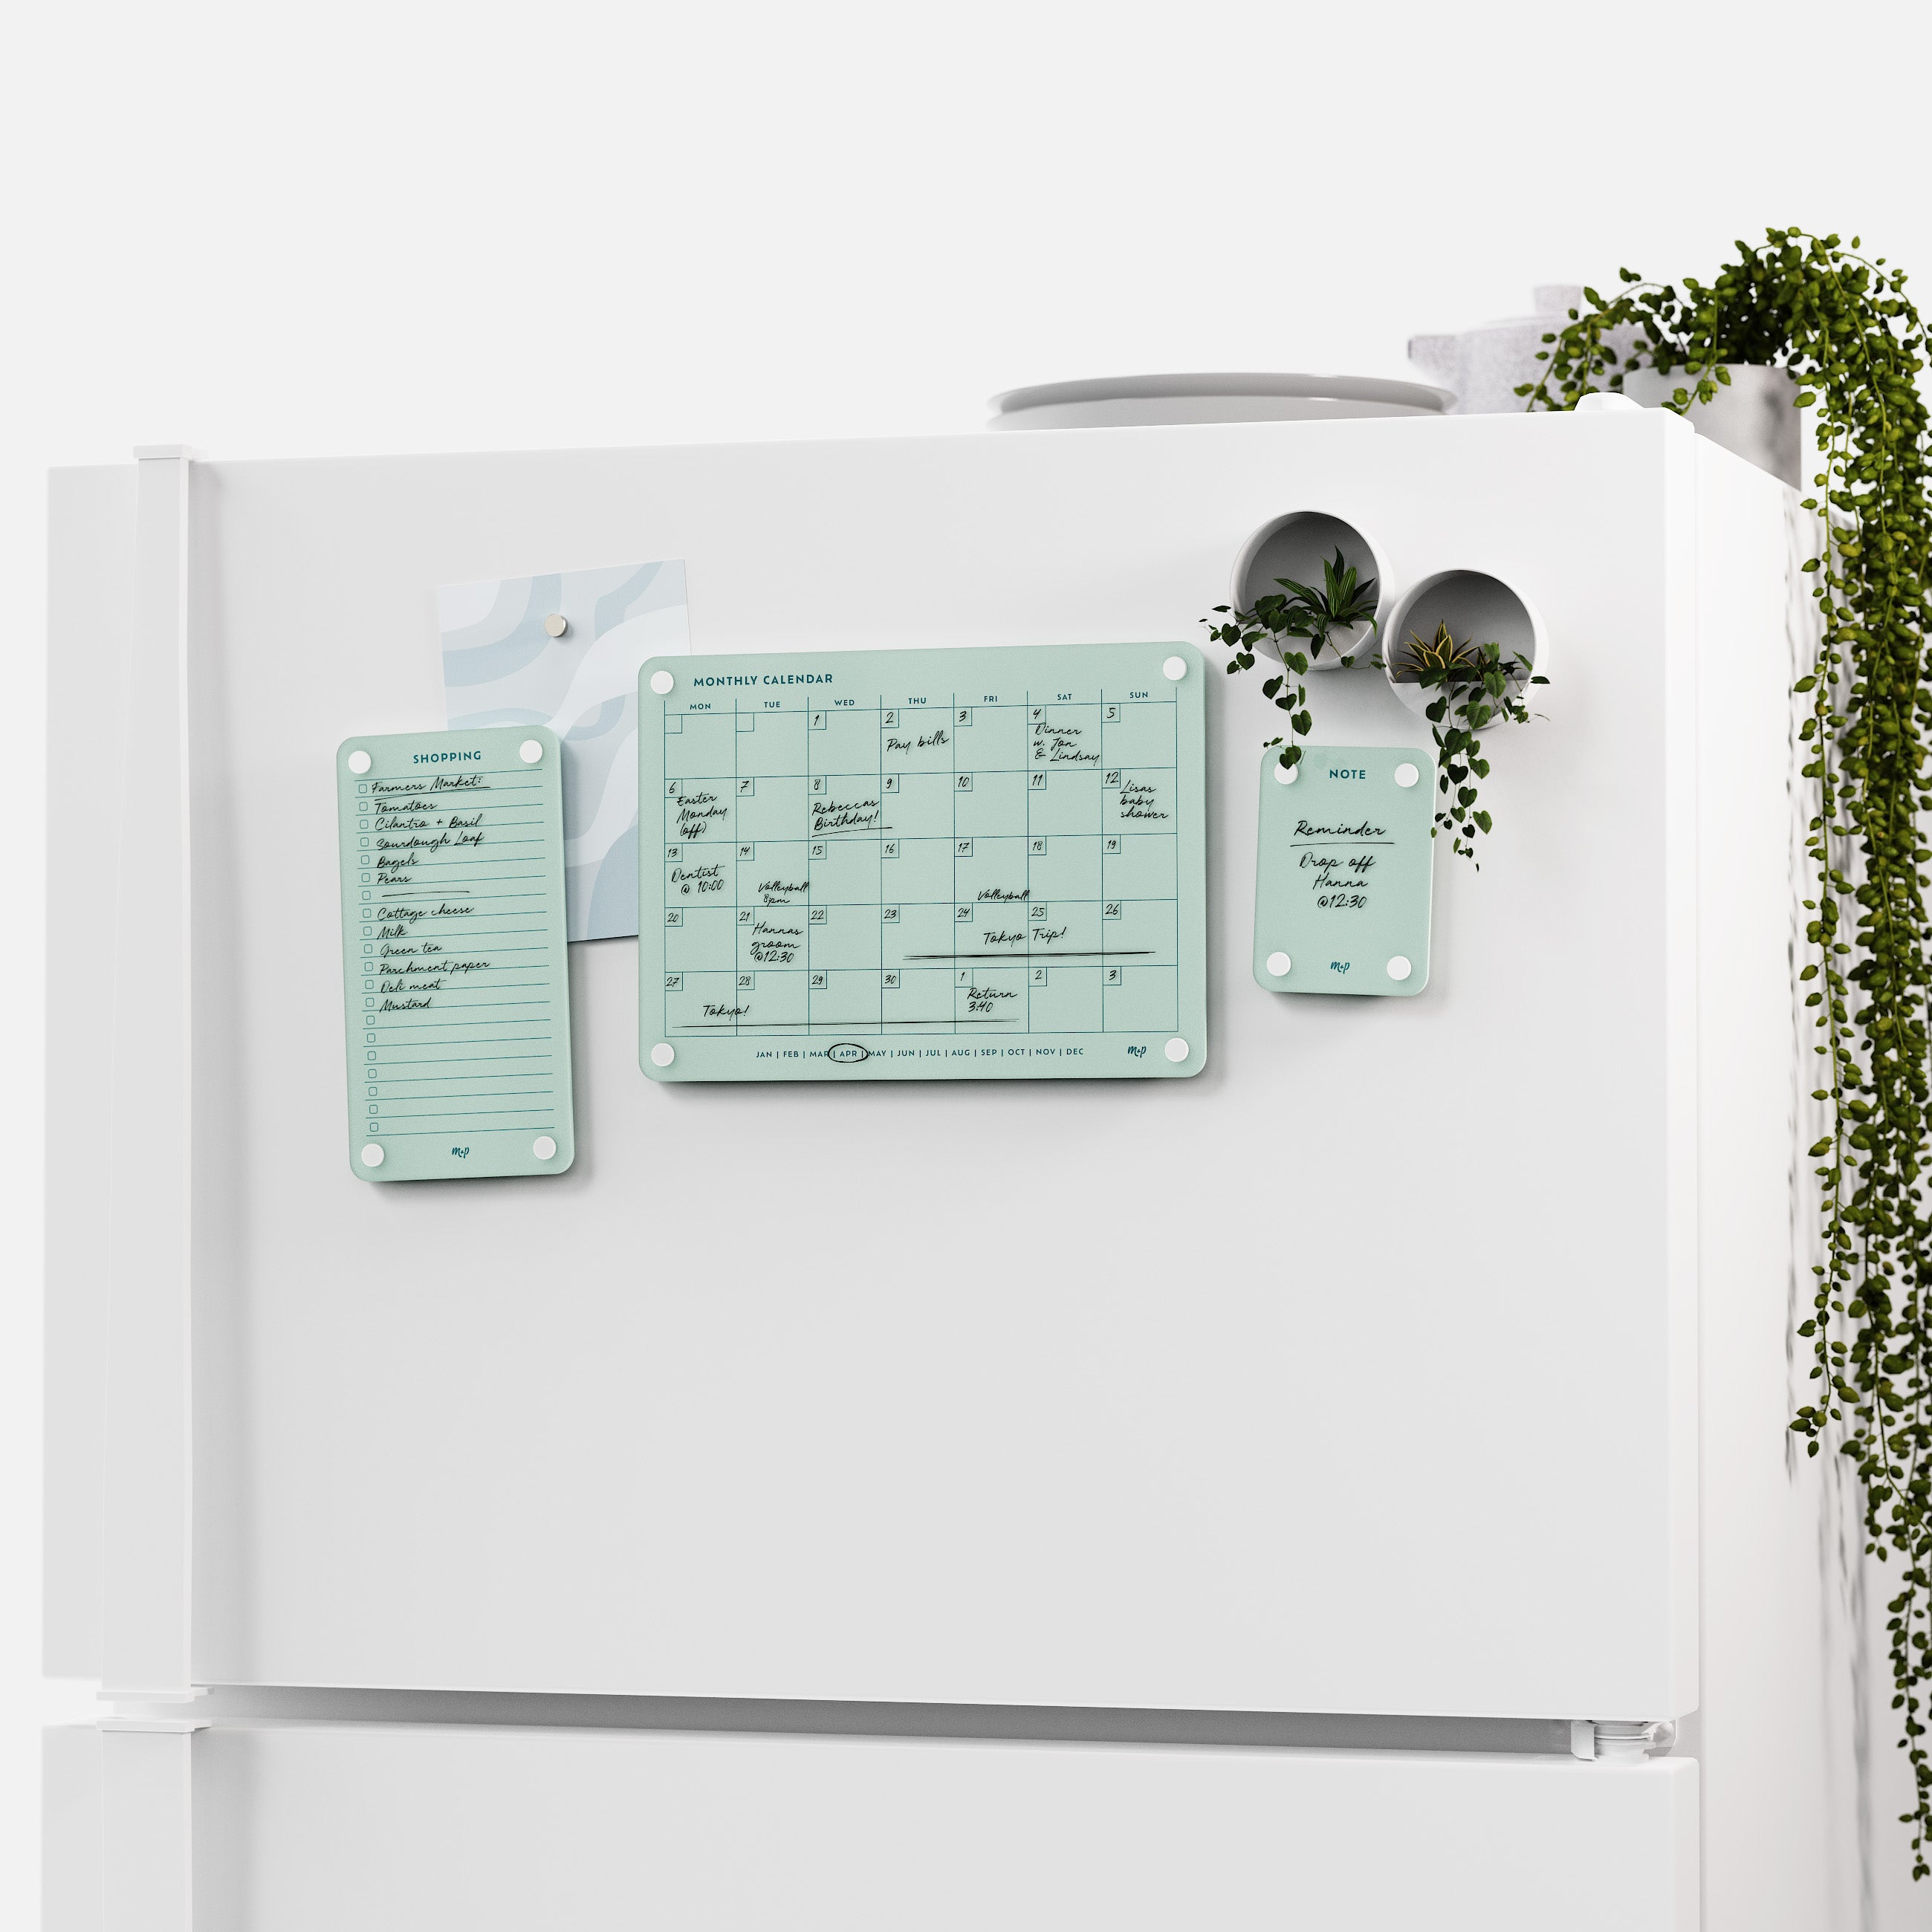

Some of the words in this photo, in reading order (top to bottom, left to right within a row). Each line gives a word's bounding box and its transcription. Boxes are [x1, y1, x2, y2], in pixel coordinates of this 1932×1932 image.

[693, 676, 758, 687] MONTHLY
[764, 674, 833, 684] CALENDAR
[886, 712, 893, 723] 2
[959, 711, 966, 722] 3
[1033, 709, 1041, 719] 4
[1107, 707, 1115, 719] 5
[814, 715, 819, 726] 1
[1035, 722, 1082, 736] Dinner
[886, 739, 911, 754] Pay
[918, 730, 950, 748] bills
[1051, 738, 1077, 750] Jon
[413, 751, 482, 764] SHOPPING
[1050, 748, 1100, 766] Lindsay
[1032, 774, 1043, 786] 11
[1105, 771, 1119, 784] 12
[1329, 769, 1366, 779] NOTE
[372, 782, 427, 793] Farmers
[430, 775, 483, 790] Market:
[669, 782, 675, 794] 6
[740, 781, 749, 792] 7
[814, 779, 819, 790] 8
[886, 778, 892, 788] 9
[958, 776, 970, 788] 10
[1120, 780, 1156, 794] Lisas
[677, 794, 718, 806] Easter
[1120, 794, 1155, 811] baby
[375, 802, 438, 814] Tomatoes
[811, 800, 880, 816] Rebeccas
[1121, 806, 1169, 819] shower
[676, 807, 727, 824] Monday
[814, 811, 878, 832] Birthday!
[375, 817, 428, 831] Cilantro
[449, 814, 483, 828] Basil
[1294, 820, 1387, 837] Reminder
[680, 821, 707, 839] (off)
[376, 832, 451, 852] Sourdough
[454, 831, 484, 846] Loaf
[958, 842, 968, 853] 17
[1032, 840, 1043, 851] 18
[1107, 840, 1117, 849] 19
[668, 848, 678, 858] 13
[740, 846, 751, 856] 14
[812, 846, 823, 855] 15
[885, 843, 895, 854] 16
[377, 852, 419, 873] Bagels
[1300, 852, 1343, 873] Drop
[1349, 855, 1376, 872] off
[377, 872, 412, 884] Pears
[672, 864, 725, 883] Dentist
[698, 879, 724, 893] 10:00
[1313, 872, 1368, 889] Hanna
[758, 881, 809, 893] Volleyball
[978, 889, 1030, 903] Volleyball
[1317, 894, 1367, 909] @12:30
[377, 907, 428, 924] Cottage
[431, 904, 475, 915] cheese
[811, 910, 824, 920] 22
[884, 909, 897, 919] 23
[957, 907, 970, 918] 24
[1031, 907, 1045, 917] 25
[1105, 904, 1118, 915] 26
[667, 912, 678, 923] 20
[739, 911, 750, 922] 21
[377, 926, 409, 939] Milk
[752, 922, 804, 936] Hannas
[984, 930, 1026, 947] Tokyo
[1032, 927, 1067, 944] Trip!
[380, 944, 418, 958] Green
[421, 942, 443, 952] tea
[751, 940, 801, 955] groom
[753, 950, 794, 963] @12:30
[379, 962, 453, 975] Parchment
[450, 961, 490, 975] paper
[739, 976, 751, 986] 28
[811, 975, 823, 985] 29
[885, 974, 897, 984] 30
[960, 971, 965, 982] 1
[1035, 970, 1043, 980] 2
[1109, 970, 1117, 980] 3
[380, 979, 406, 993] Deli
[409, 979, 447, 990] meat
[666, 976, 679, 988] 27
[967, 987, 1018, 999] Return
[379, 998, 432, 1012] Mustard
[968, 1001, 993, 1012] 3:40
[703, 1005, 750, 1021] Tokyo!
